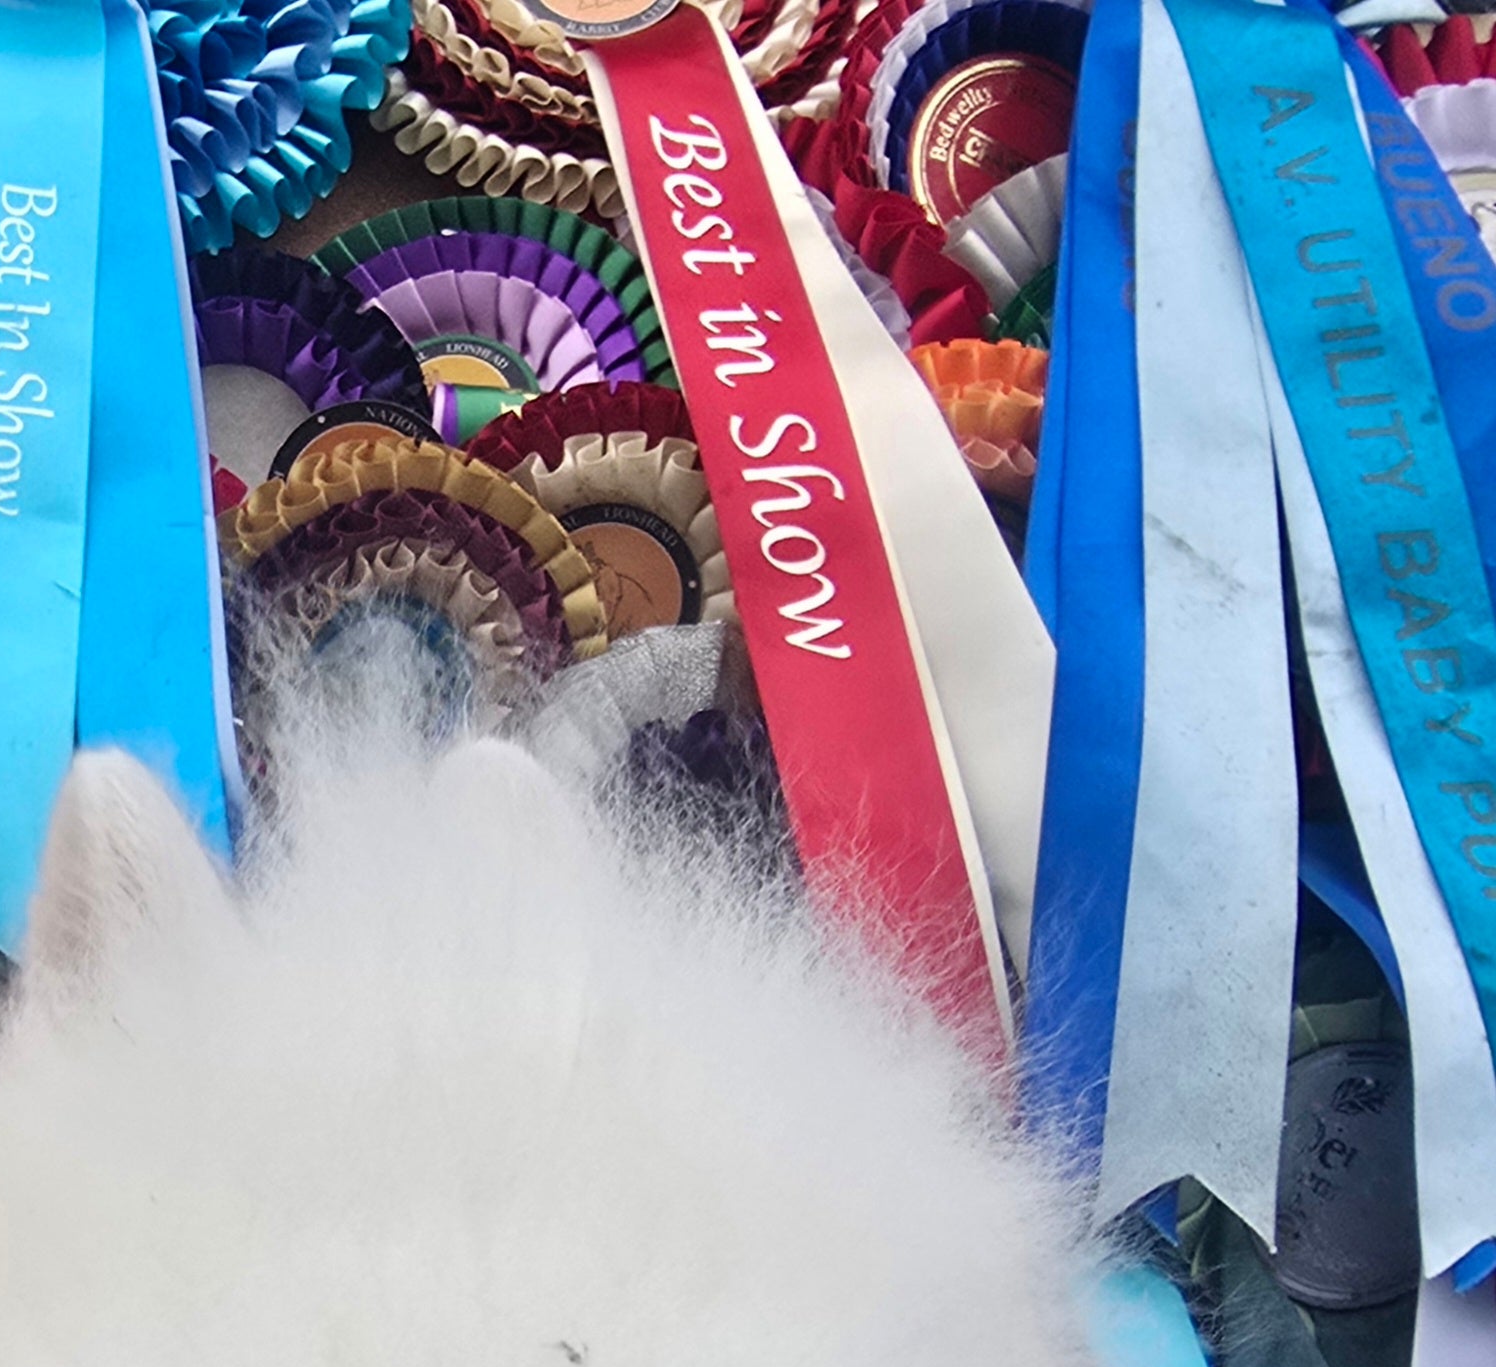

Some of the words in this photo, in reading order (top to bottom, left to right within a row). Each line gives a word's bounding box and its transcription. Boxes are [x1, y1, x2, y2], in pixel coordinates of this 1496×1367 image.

[649, 113, 757, 276] Best
[445, 343, 509, 370] LIONHEAD
[698, 302, 784, 389] in
[604, 507, 678, 547] LIONHEAD
[730, 413, 853, 659] Show
[1295, 229, 1425, 497] UTILITY
[1374, 528, 1484, 748] BABY
[1438, 780, 1496, 900] PU
